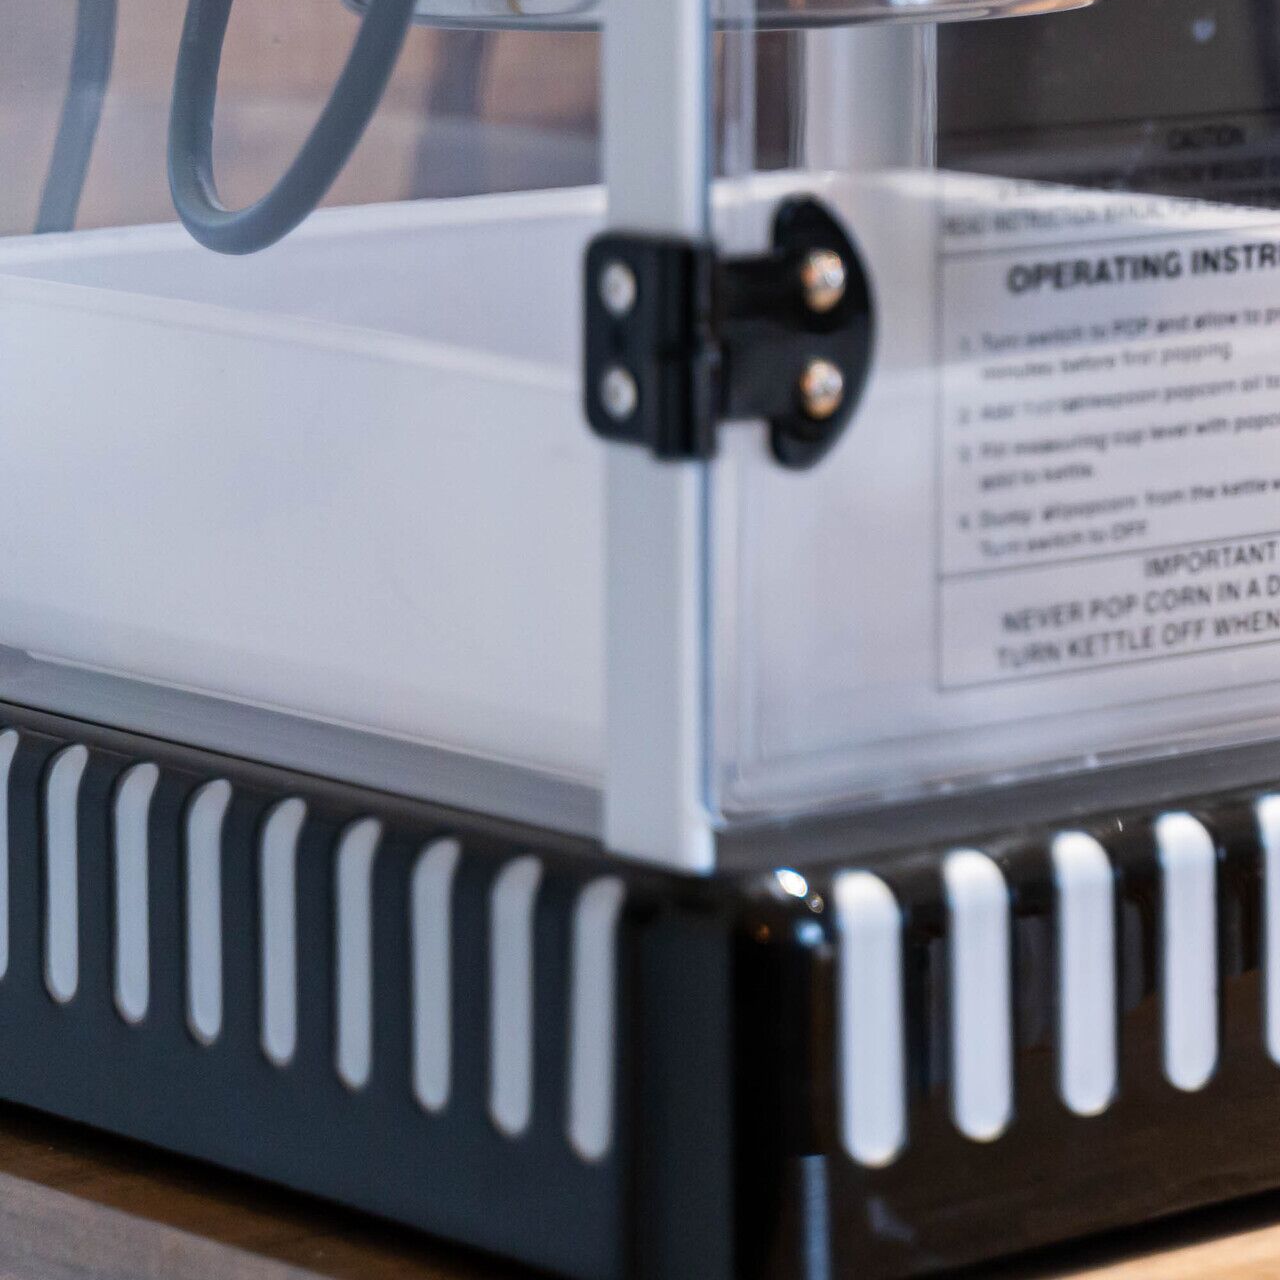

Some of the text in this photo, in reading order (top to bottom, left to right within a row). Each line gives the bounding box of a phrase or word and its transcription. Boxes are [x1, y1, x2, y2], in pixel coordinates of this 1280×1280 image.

[1007, 249, 1183, 295] OPERATING
[1144, 540, 1279, 578] IMPORTANT
[1002, 600, 1085, 634] NEVER
[1088, 593, 1139, 620] POP
[1142, 583, 1212, 615] CORN
[1216, 580, 1242, 602] IN
[1246, 576, 1262, 598] A
[997, 641, 1061, 669] TURN
[1066, 624, 1154, 660] KETTLE
[1161, 617, 1206, 646] OFF
